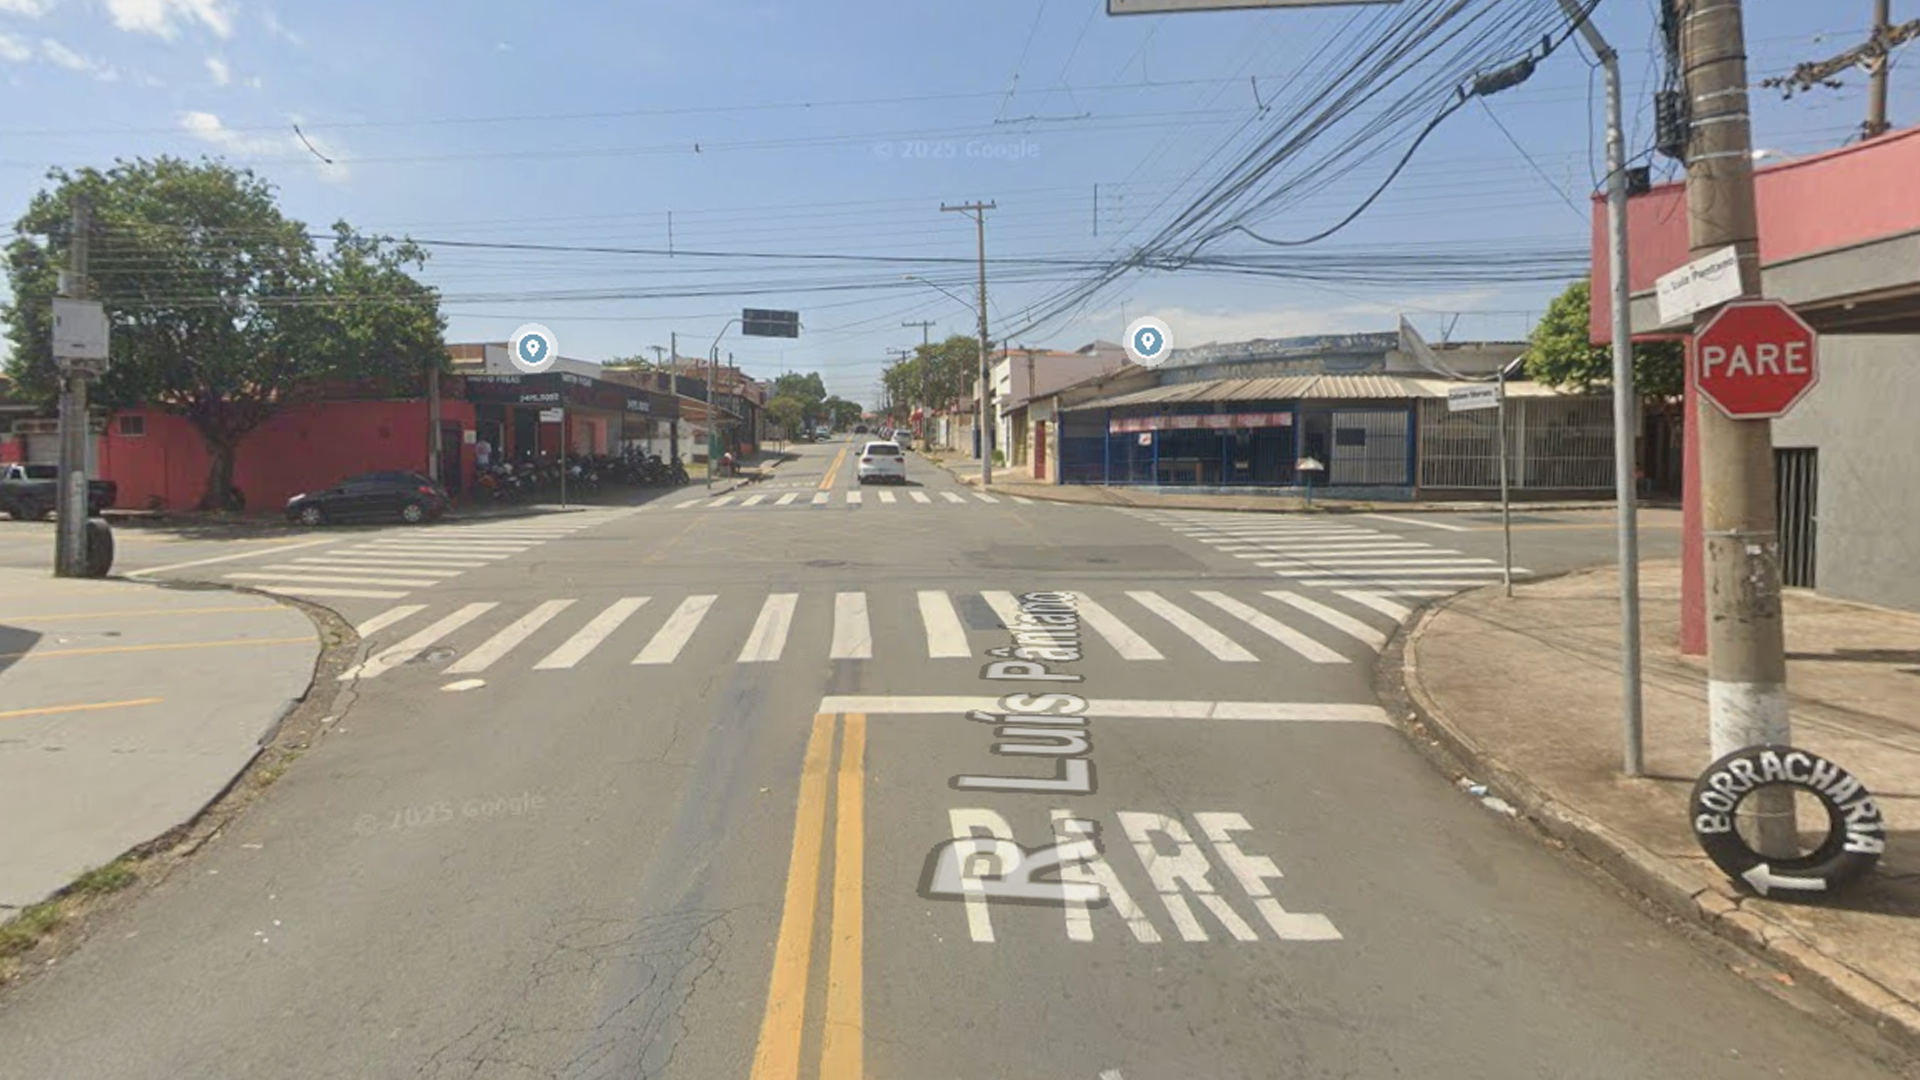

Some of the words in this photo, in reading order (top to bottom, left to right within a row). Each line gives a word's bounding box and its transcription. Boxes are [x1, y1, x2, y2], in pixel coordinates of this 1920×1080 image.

[1702, 341, 1808, 379] PARE
[1695, 750, 1886, 855] BORRACHARIA
[948, 808, 1344, 943] PARE
